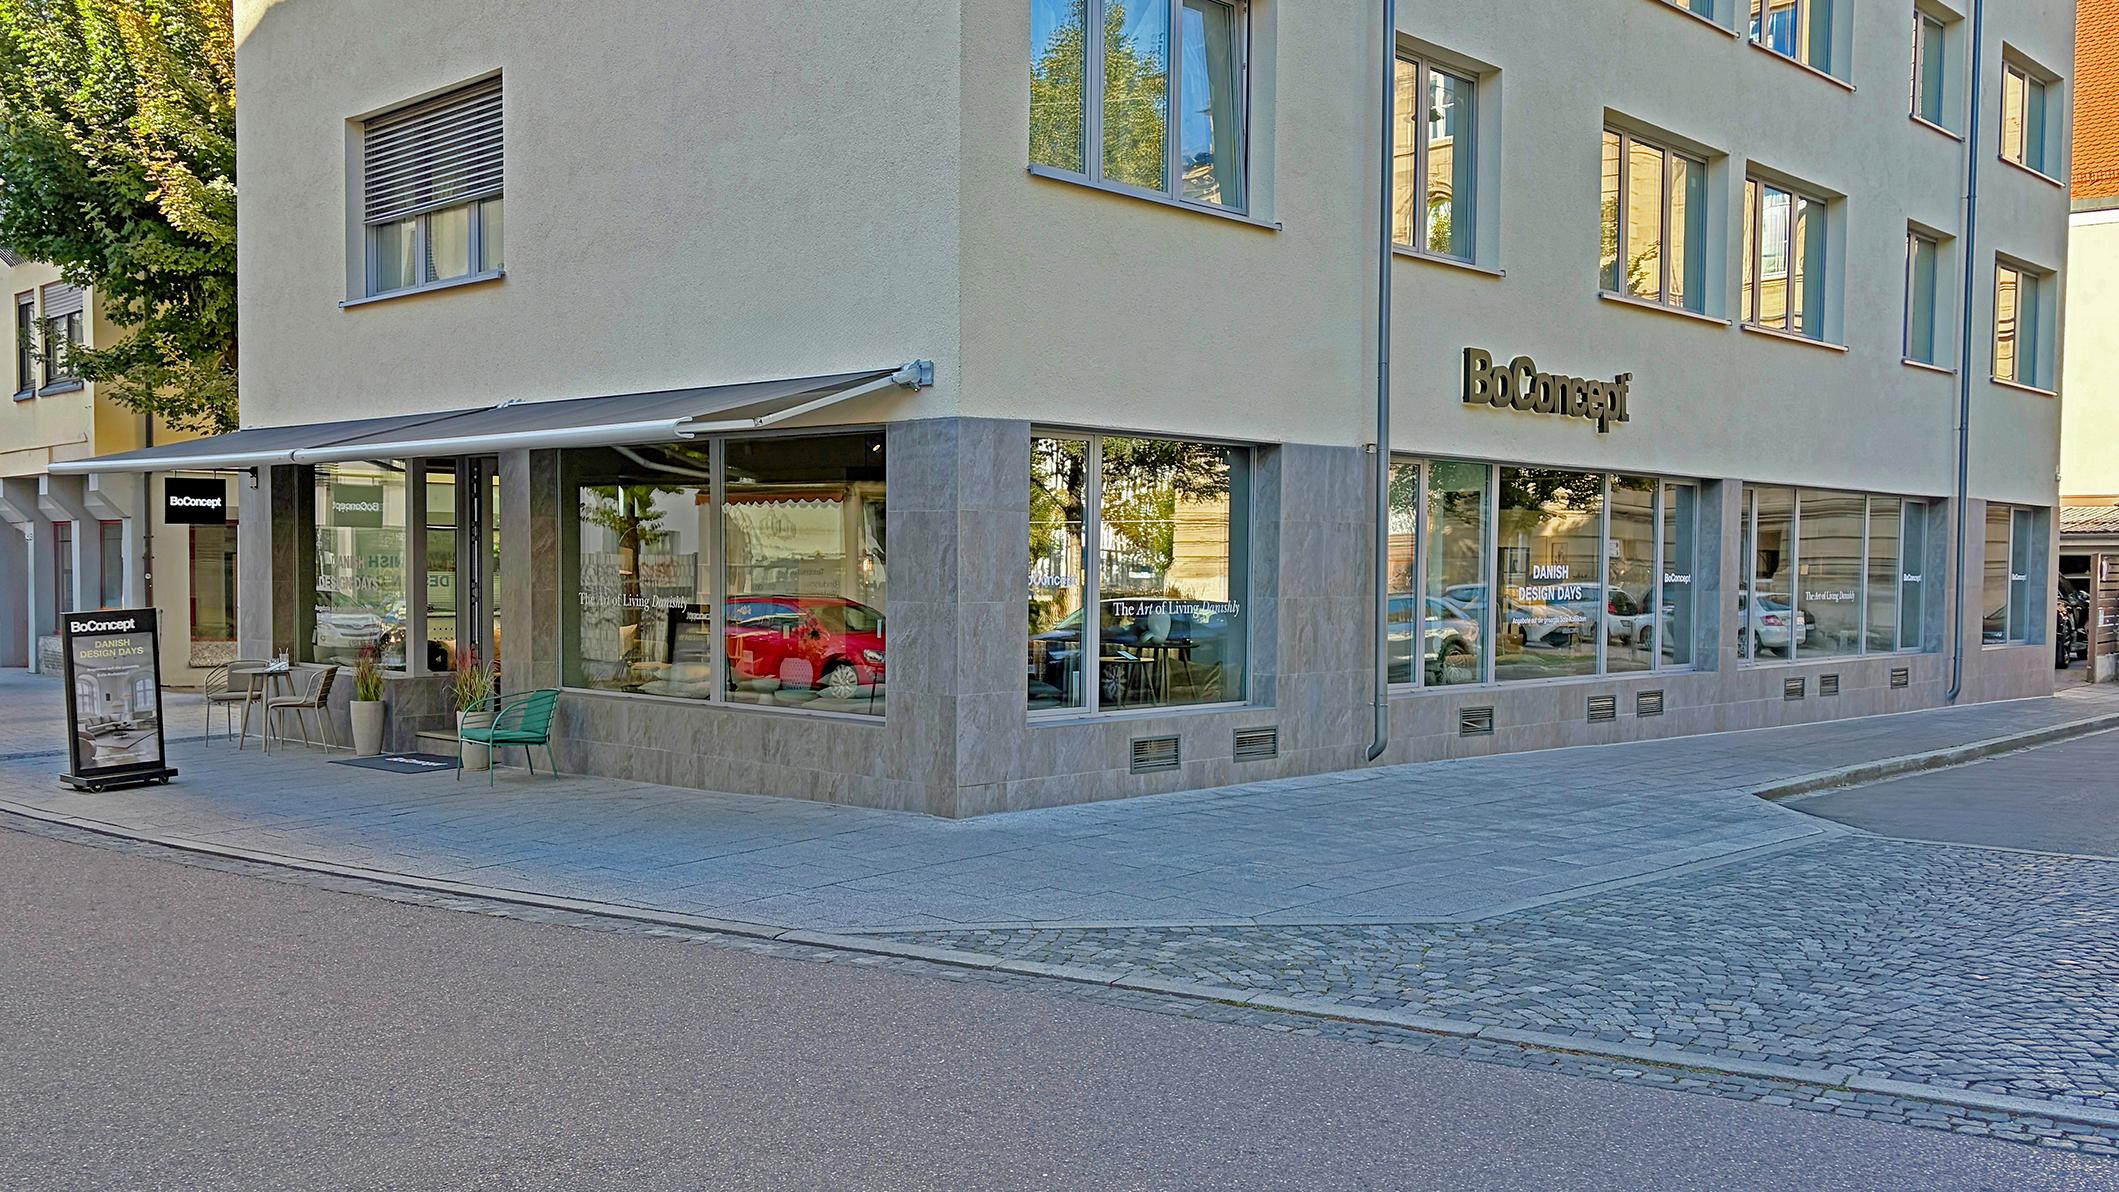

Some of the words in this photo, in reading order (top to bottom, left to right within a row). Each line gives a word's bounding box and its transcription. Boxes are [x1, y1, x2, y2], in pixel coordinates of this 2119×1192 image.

[1463, 347, 1631, 433] BoConcept
[170, 496, 222, 509] BoConcept
[1533, 565, 1569, 579] DANISH
[1664, 572, 1691, 584] BoConcept
[1518, 586, 1555, 601] DESIGN
[1557, 586, 1582, 600] DAYS
[579, 592, 595, 605] The
[623, 593, 649, 612] Living
[651, 594, 688, 613] Danishly
[1113, 602, 1135, 616] The
[1136, 602, 1153, 615] Art
[1155, 601, 1166, 615] of
[1168, 601, 1200, 618] Living
[1203, 600, 1240, 617] Danishly
[70, 618, 136, 633] BoConcept
[94, 638, 131, 649] DANISH
[80, 649, 116, 659] DESIGN
[118, 646, 144, 656] DAYS
